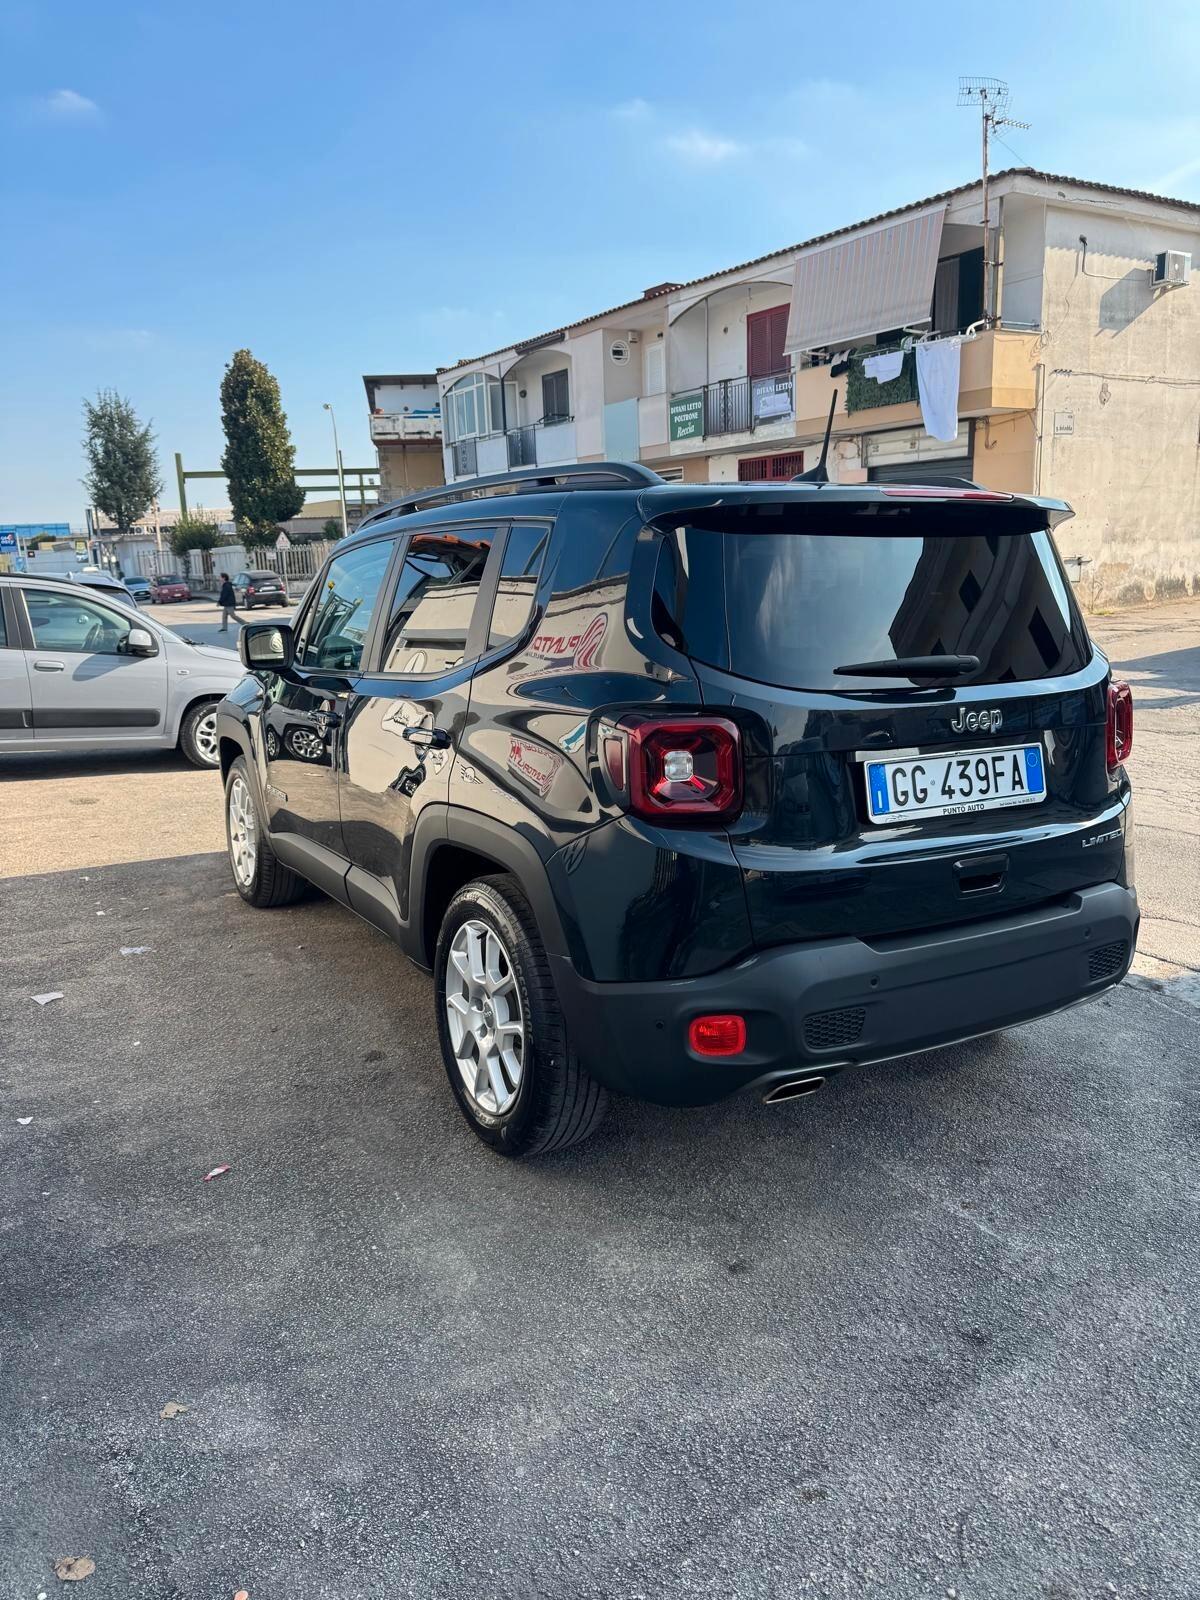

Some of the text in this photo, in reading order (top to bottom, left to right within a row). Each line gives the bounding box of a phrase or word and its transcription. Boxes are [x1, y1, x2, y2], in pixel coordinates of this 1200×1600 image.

[776, 382, 792, 391] LETTO
[687, 401, 702, 411] LETTO
[674, 412, 699, 423] POLTRONE
[951, 707, 1003, 734] Jeep
[892, 765, 929, 806] GG
[941, 754, 1025, 799] 439FA
[943, 803, 985, 815] PUNTO AUTO
